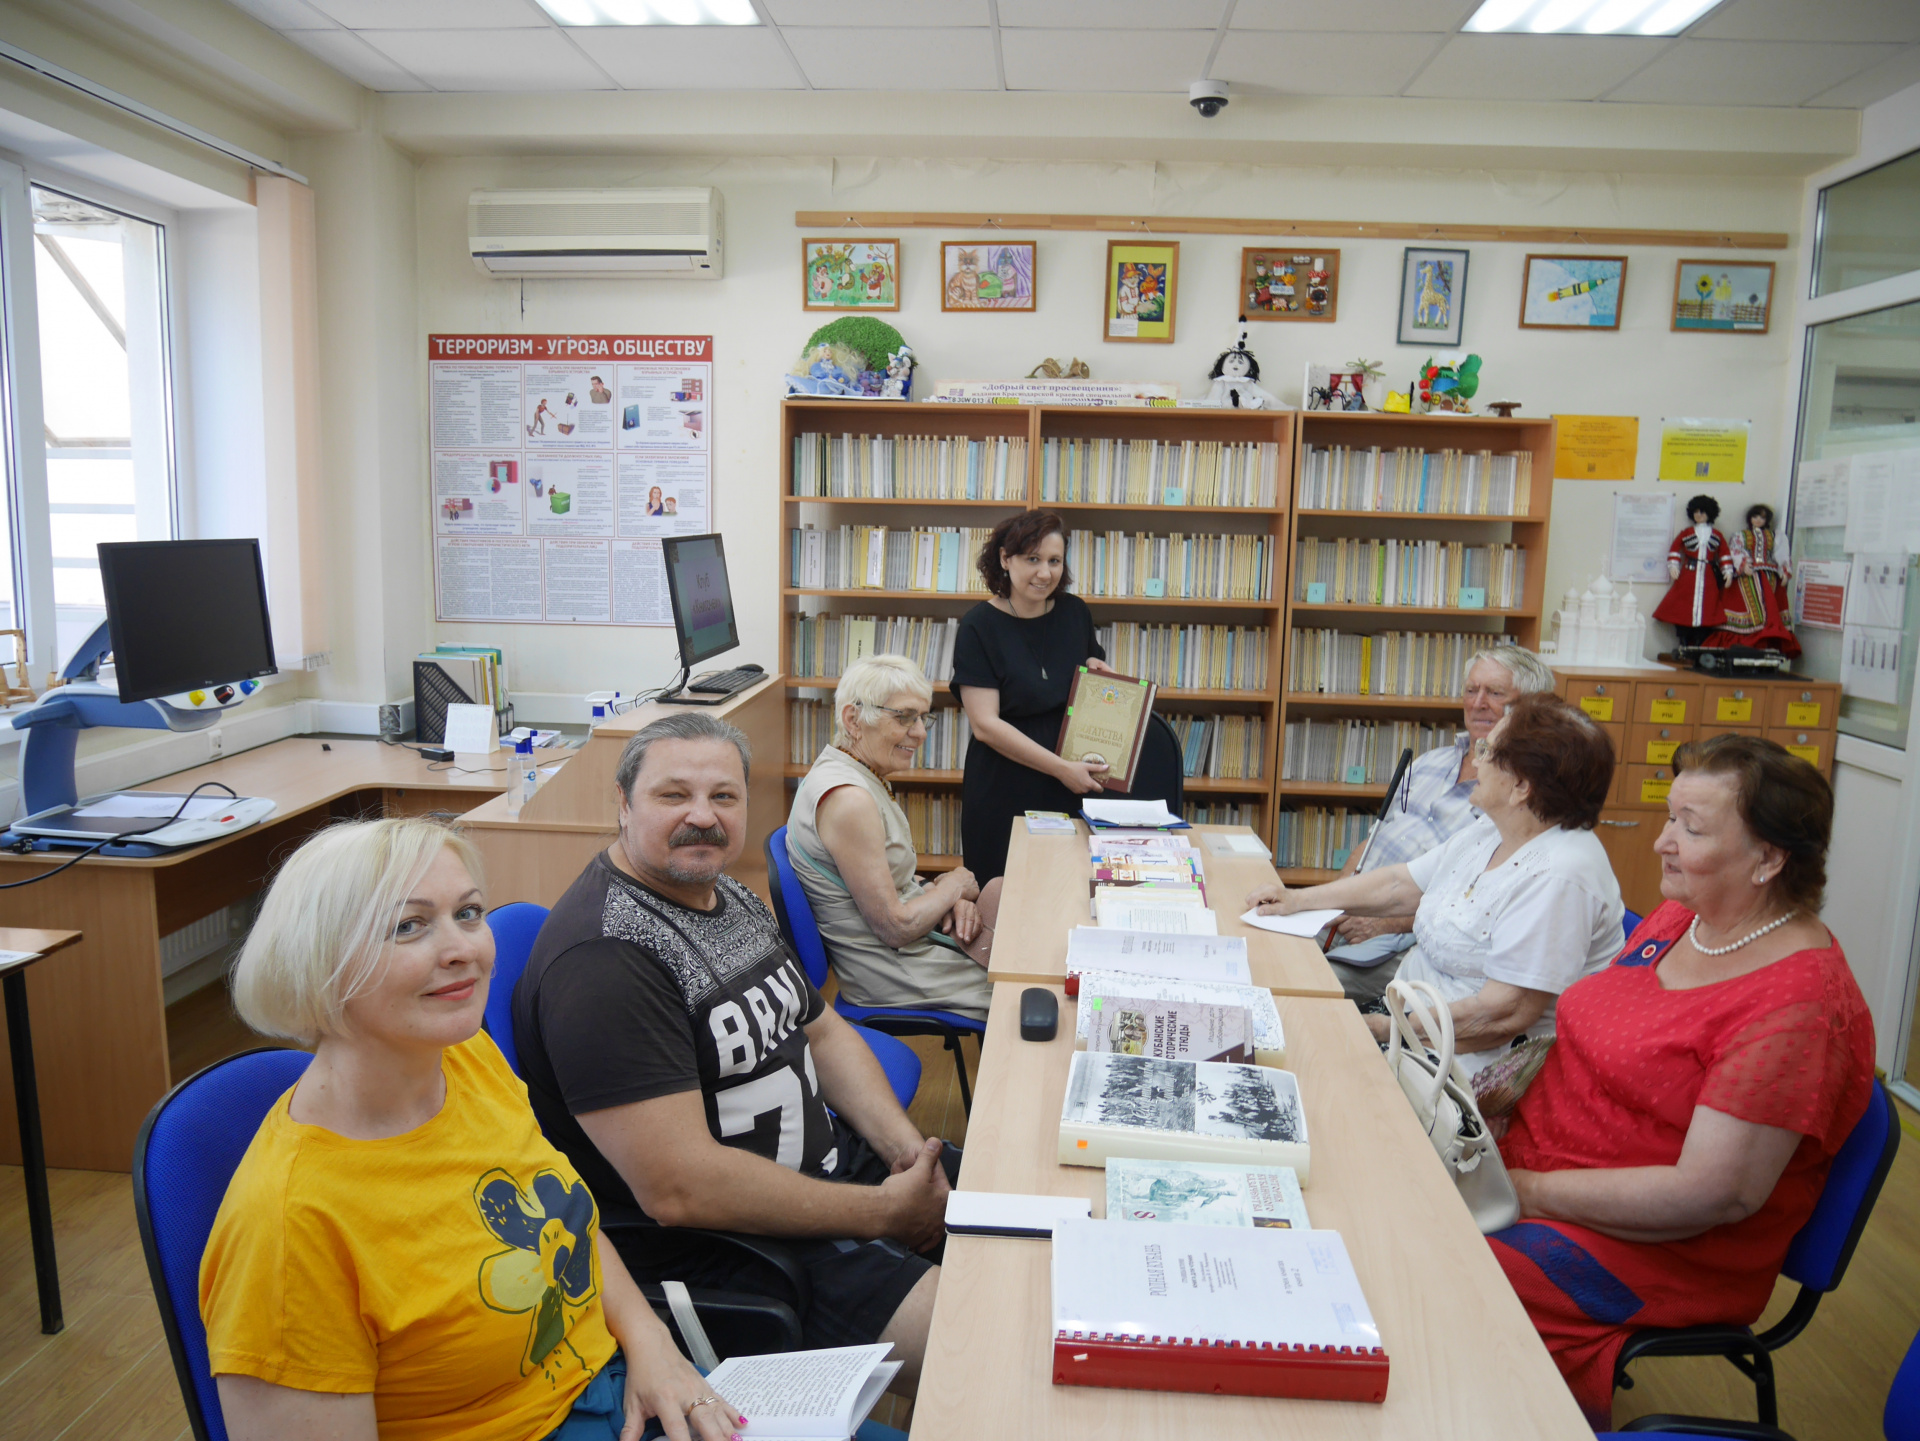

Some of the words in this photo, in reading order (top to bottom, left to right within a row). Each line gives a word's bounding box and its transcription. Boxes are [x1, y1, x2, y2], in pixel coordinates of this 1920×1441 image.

[436, 339, 533, 355] ТЕРРОРИЗМ
[547, 340, 609, 357] УГРОЗА
[613, 340, 706, 358] ОБЩЕСТВУ
[709, 959, 809, 1078] BRN
[1153, 1015, 1165, 1058] КУБАНСКИЕ
[1166, 1010, 1178, 1060] СТОРИЧЕСКИЕ
[1179, 1024, 1189, 1053] ЭТЮДЫ
[1268, 1174, 1284, 1203] ИСТОРИЯ
[1146, 1269, 1168, 1297] РОДНАЯ
